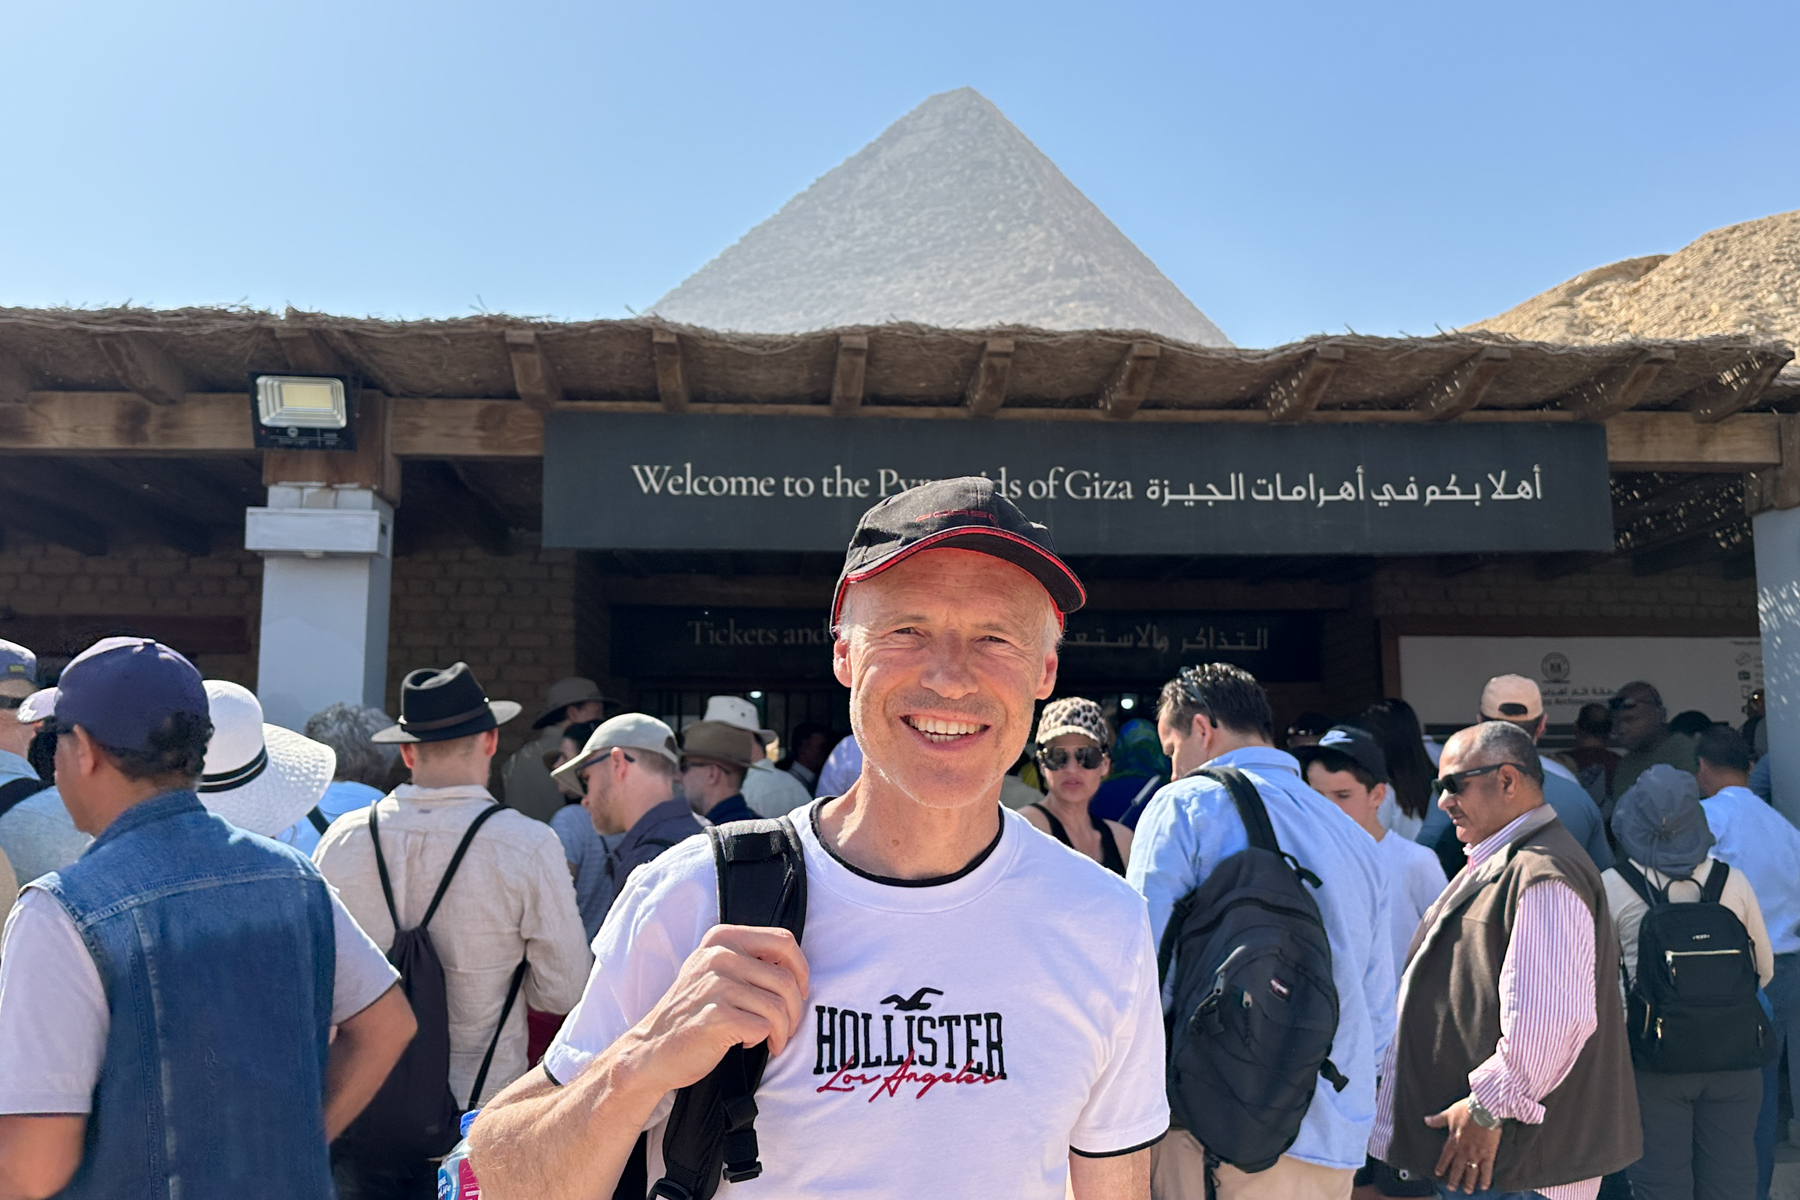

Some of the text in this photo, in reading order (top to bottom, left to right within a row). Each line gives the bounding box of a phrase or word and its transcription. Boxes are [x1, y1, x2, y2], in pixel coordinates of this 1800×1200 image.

[630, 461, 776, 497] Welcome
[783, 474, 815, 498] to
[821, 463, 870, 498] the
[1027, 465, 1065, 500] of
[1064, 469, 1134, 500] Giza
[1145, 463, 1542, 508] أهلا بكم في أهرامات الجيزة
[914, 508, 1001, 529] PORS
[687, 617, 830, 646] Tickets and
[1180, 625, 1269, 654] التذاكر
[813, 1005, 1007, 1080] HOLLISTER
[816, 1049, 1002, 1103] Los Angeles
